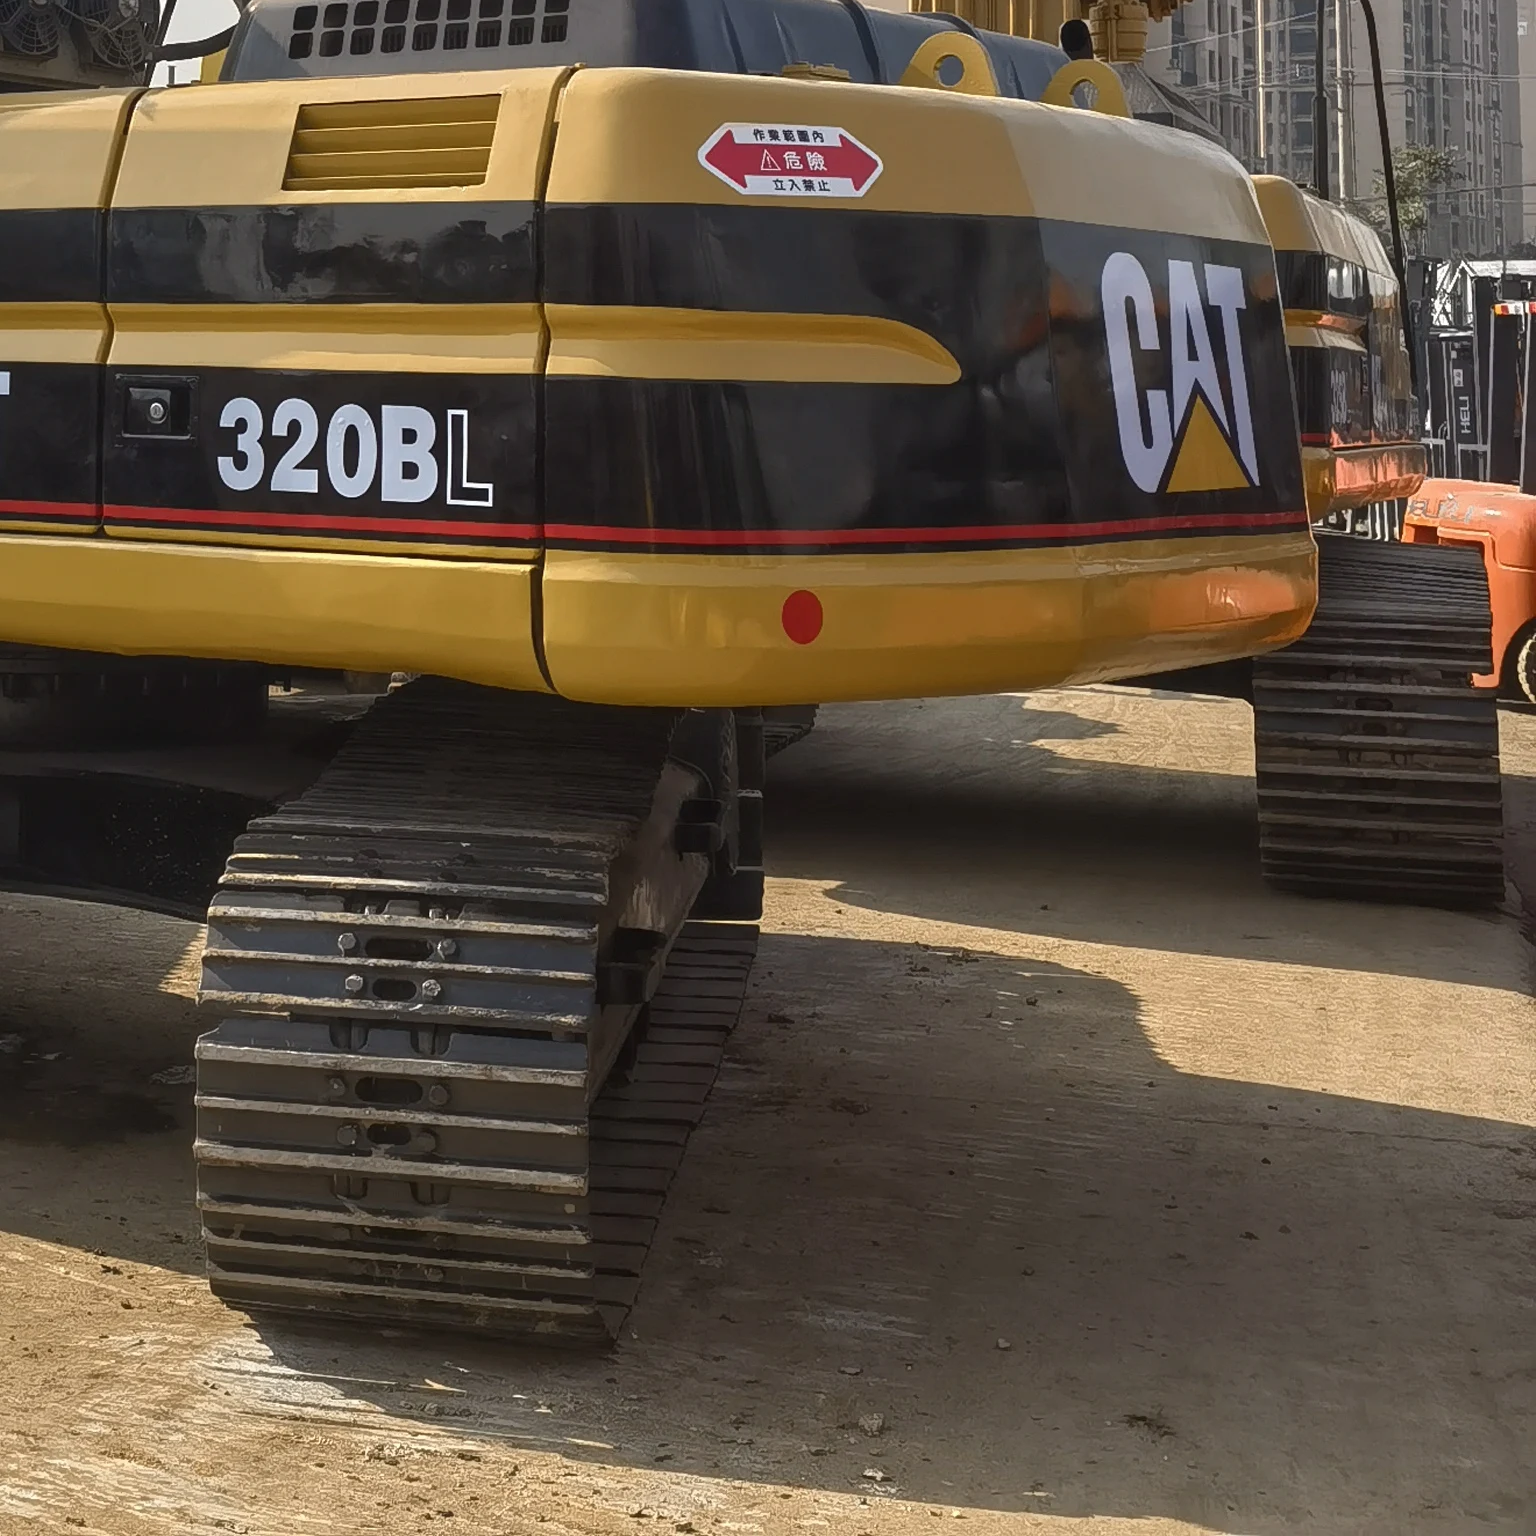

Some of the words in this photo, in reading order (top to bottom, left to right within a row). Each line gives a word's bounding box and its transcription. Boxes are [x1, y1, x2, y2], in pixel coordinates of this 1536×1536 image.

[772, 178, 831, 192] 立入禁止
[1101, 251, 1261, 493] CAT
[1458, 395, 1472, 434] HELI
